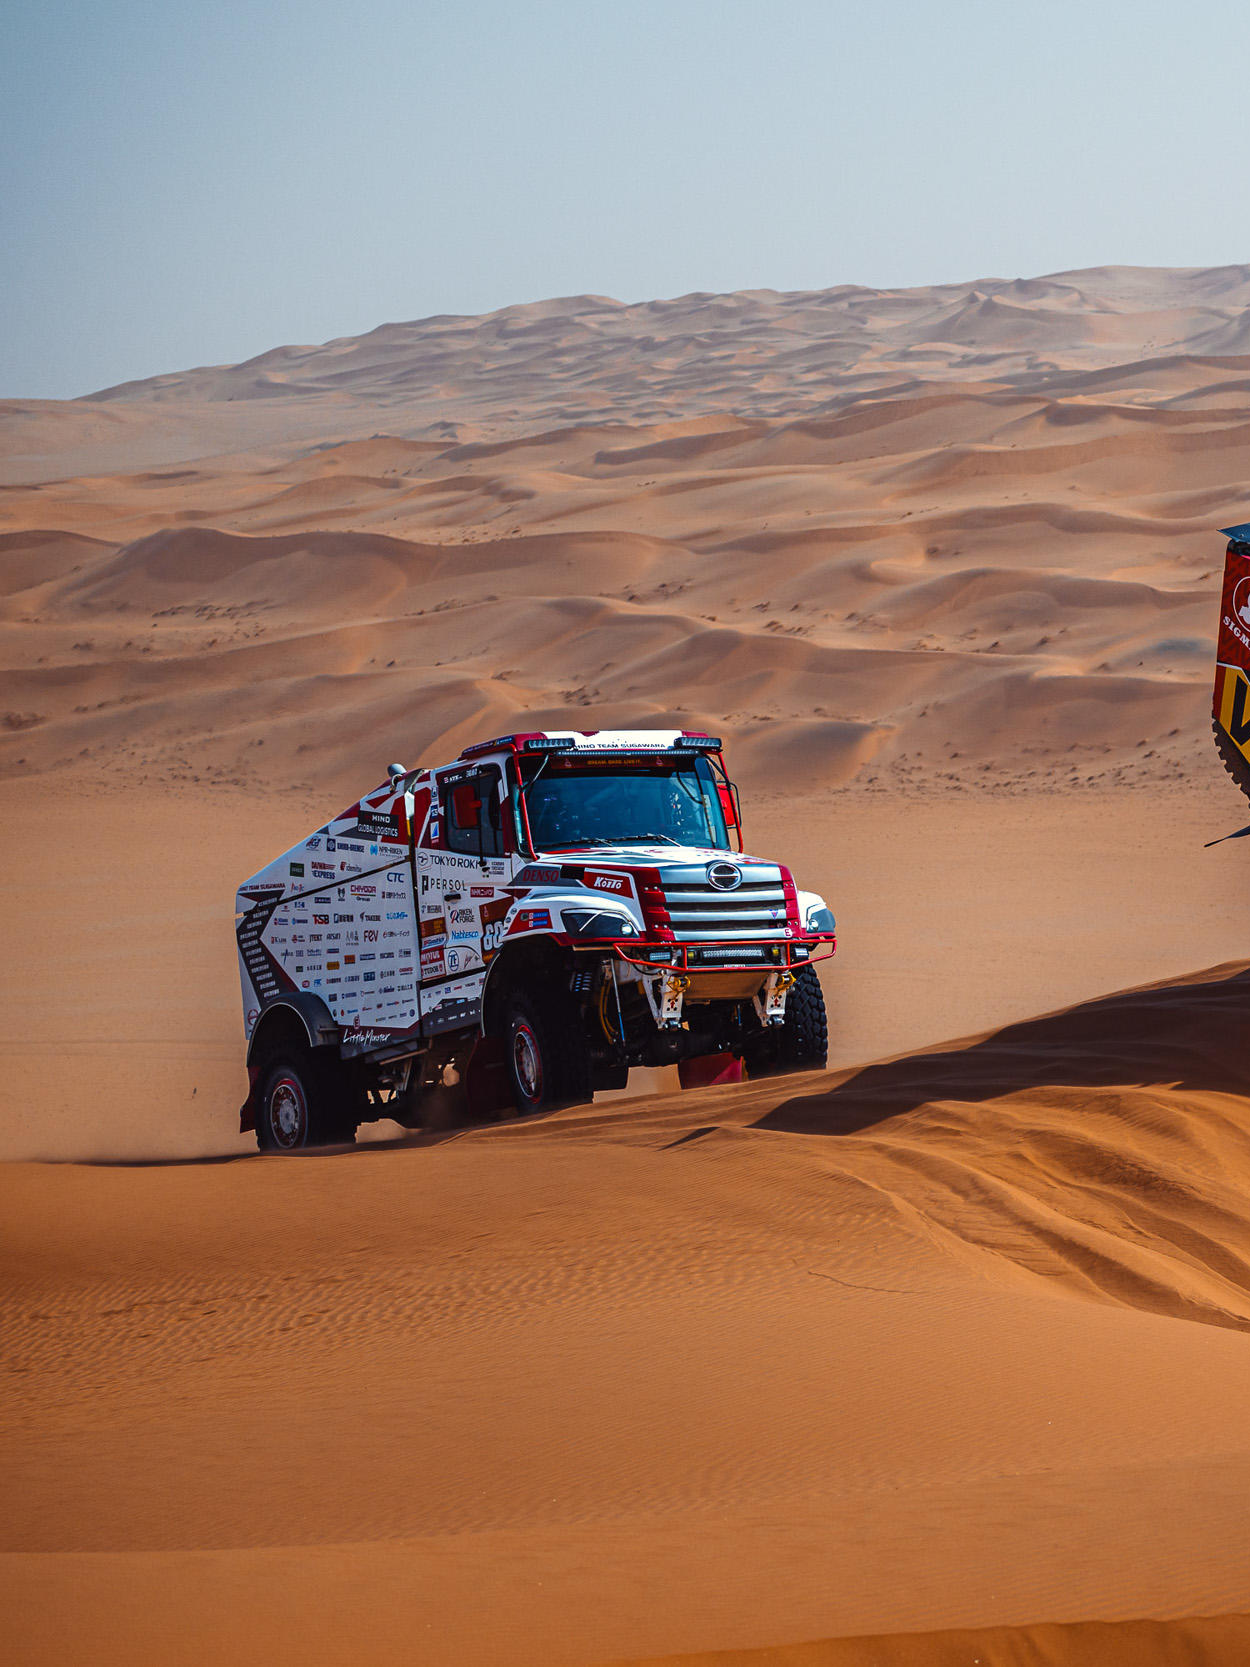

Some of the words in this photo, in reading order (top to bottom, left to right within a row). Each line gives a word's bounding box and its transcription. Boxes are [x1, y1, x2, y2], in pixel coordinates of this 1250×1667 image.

[372, 814, 391, 823] HINO
[430, 854, 456, 867] TOKYO
[386, 872, 405, 883] CTC
[523, 870, 560, 883] DENSO
[431, 878, 467, 891] PERSOL
[459, 908, 473, 916] RIKEN
[459, 915, 475, 923] FORGE
[451, 930, 479, 940] Nabtesco
